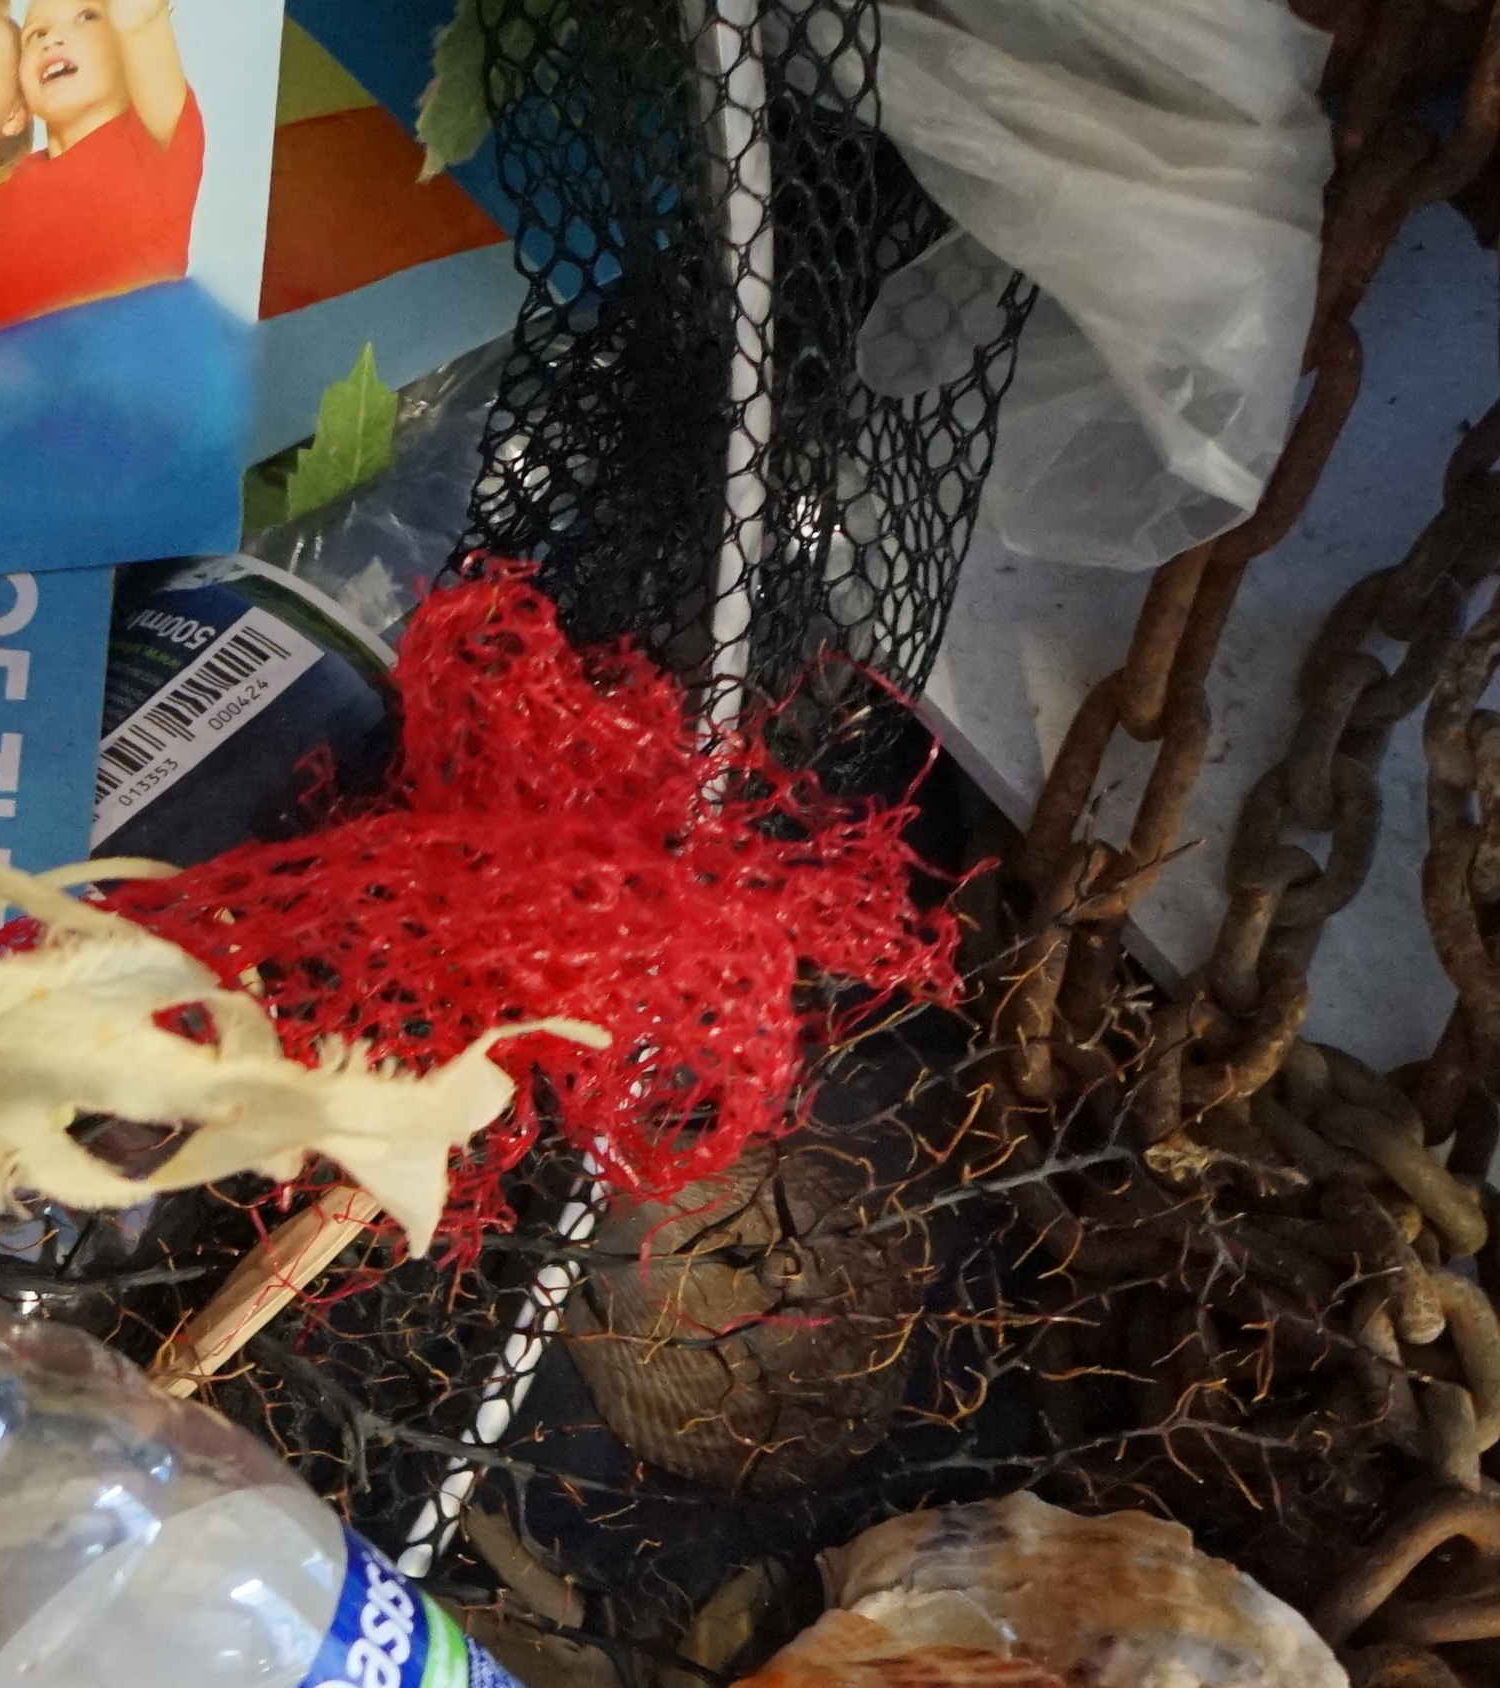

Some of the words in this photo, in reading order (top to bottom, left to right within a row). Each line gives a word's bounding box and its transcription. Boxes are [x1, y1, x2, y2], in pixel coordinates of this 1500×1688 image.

[126, 607, 217, 651] 500ml
[117, 756, 181, 808] 013353
[206, 676, 270, 732] 000424
